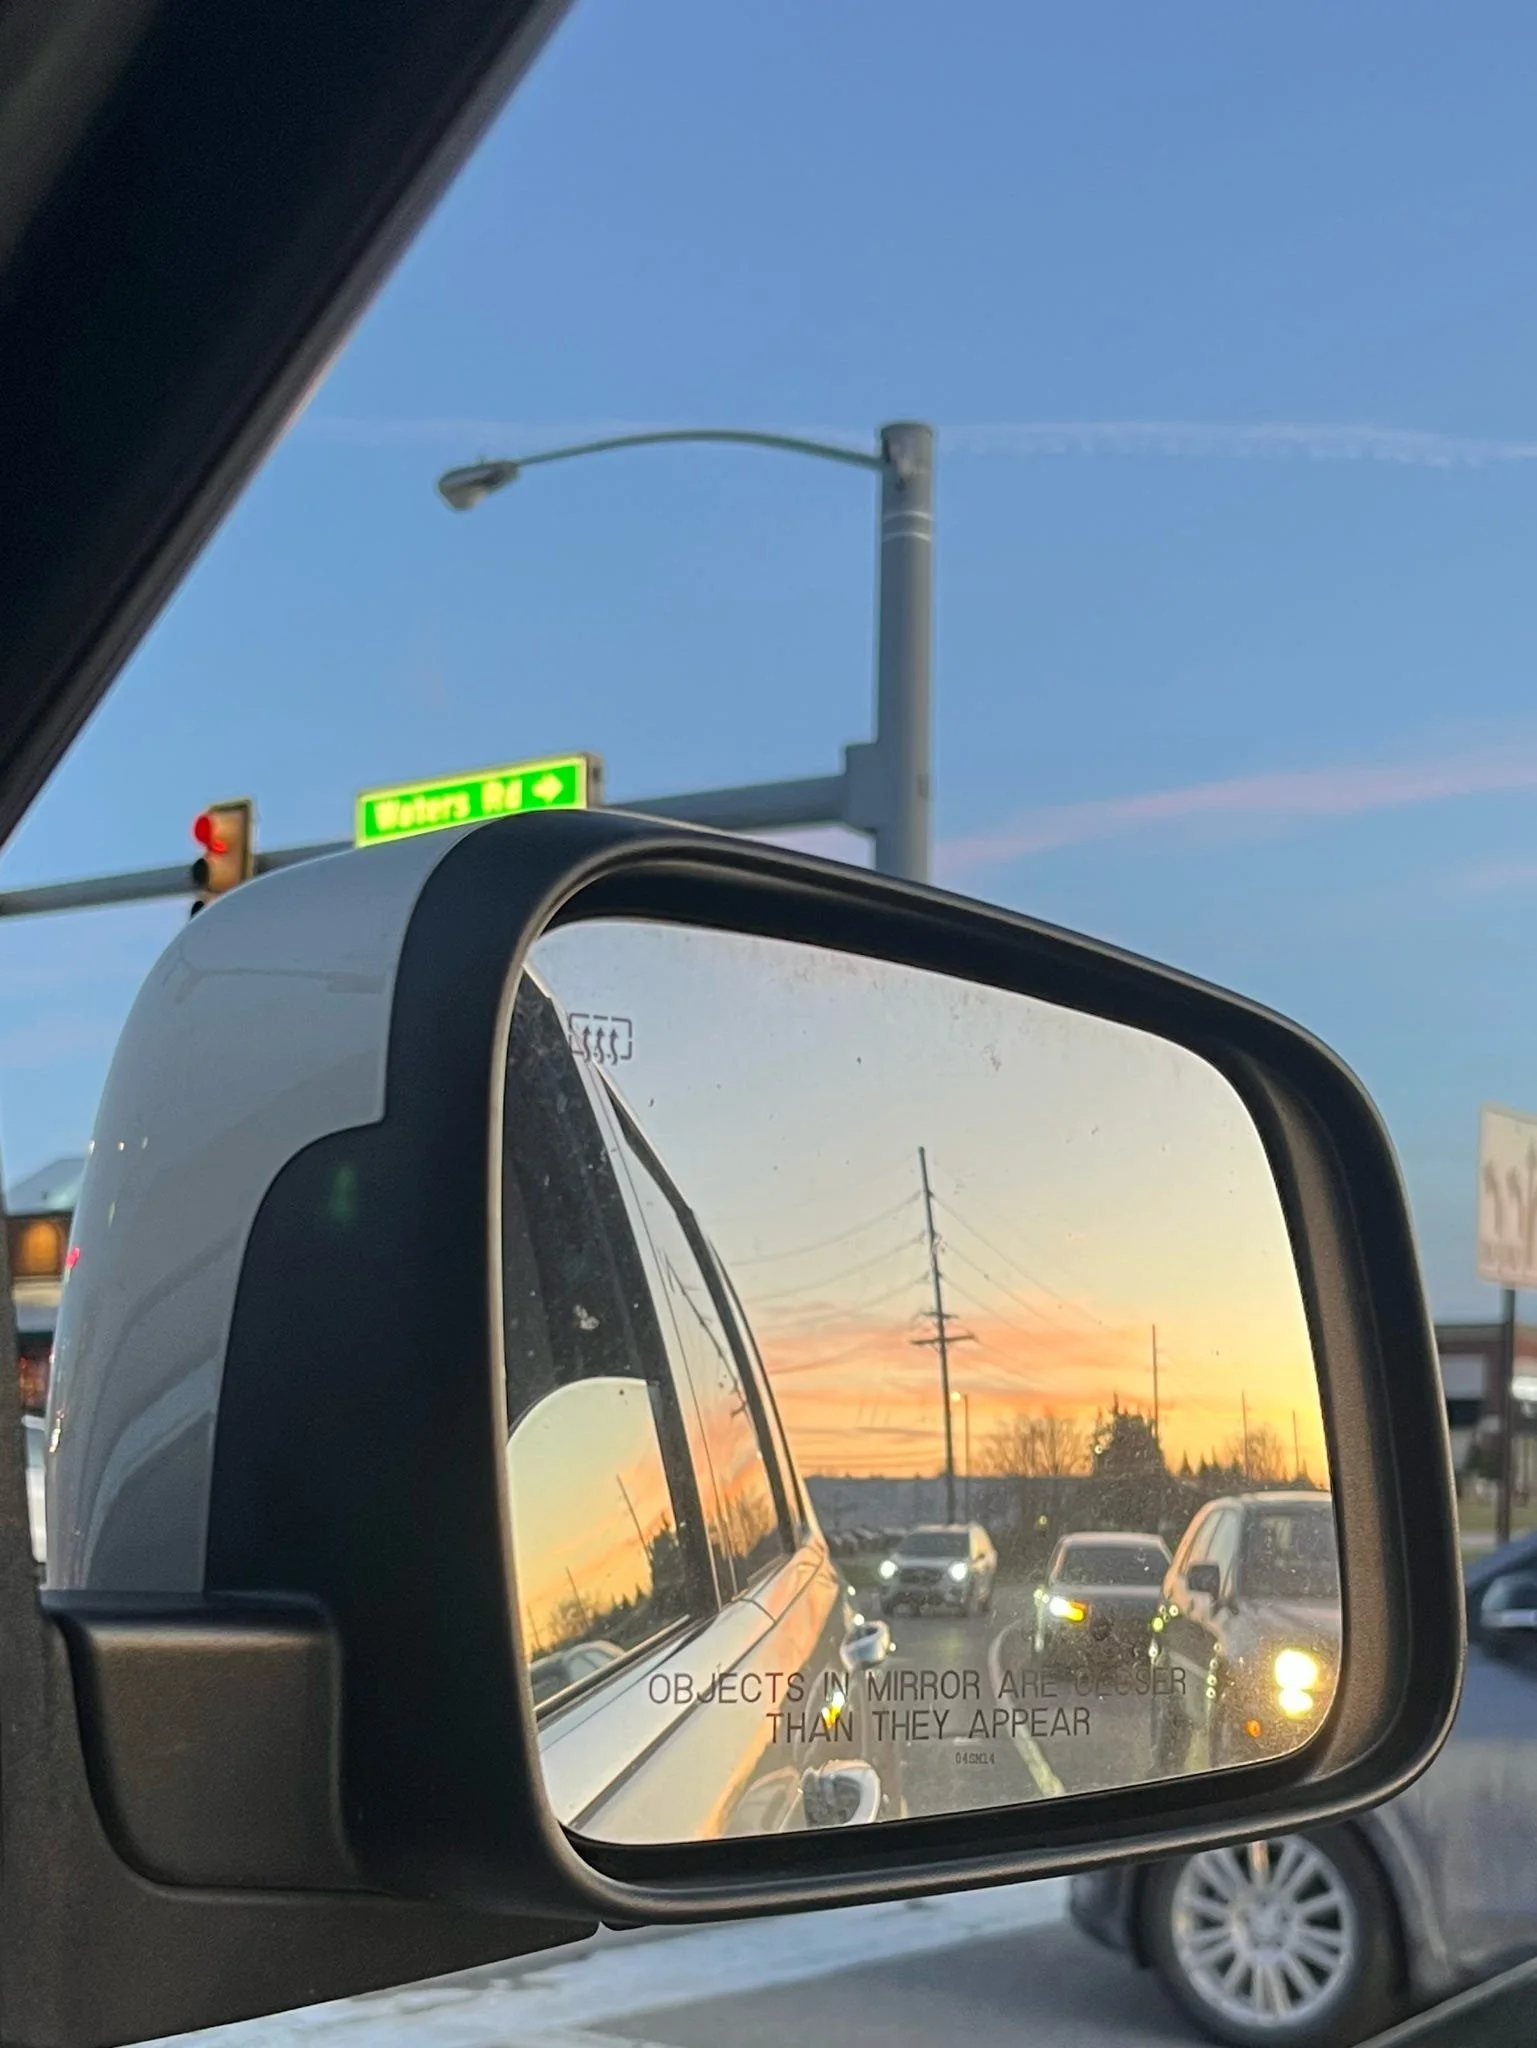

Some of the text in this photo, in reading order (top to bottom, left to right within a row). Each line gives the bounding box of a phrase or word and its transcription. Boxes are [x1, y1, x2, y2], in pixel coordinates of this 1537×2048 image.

[374, 778, 523, 832] Waters Rd
[649, 1672, 804, 1704] OBJECTS
[824, 1671, 849, 1703] IN
[868, 1669, 980, 1701] MIRROR
[998, 1667, 1057, 1699] ARE
[766, 1707, 1090, 1743] THAN THEY APPEAR
